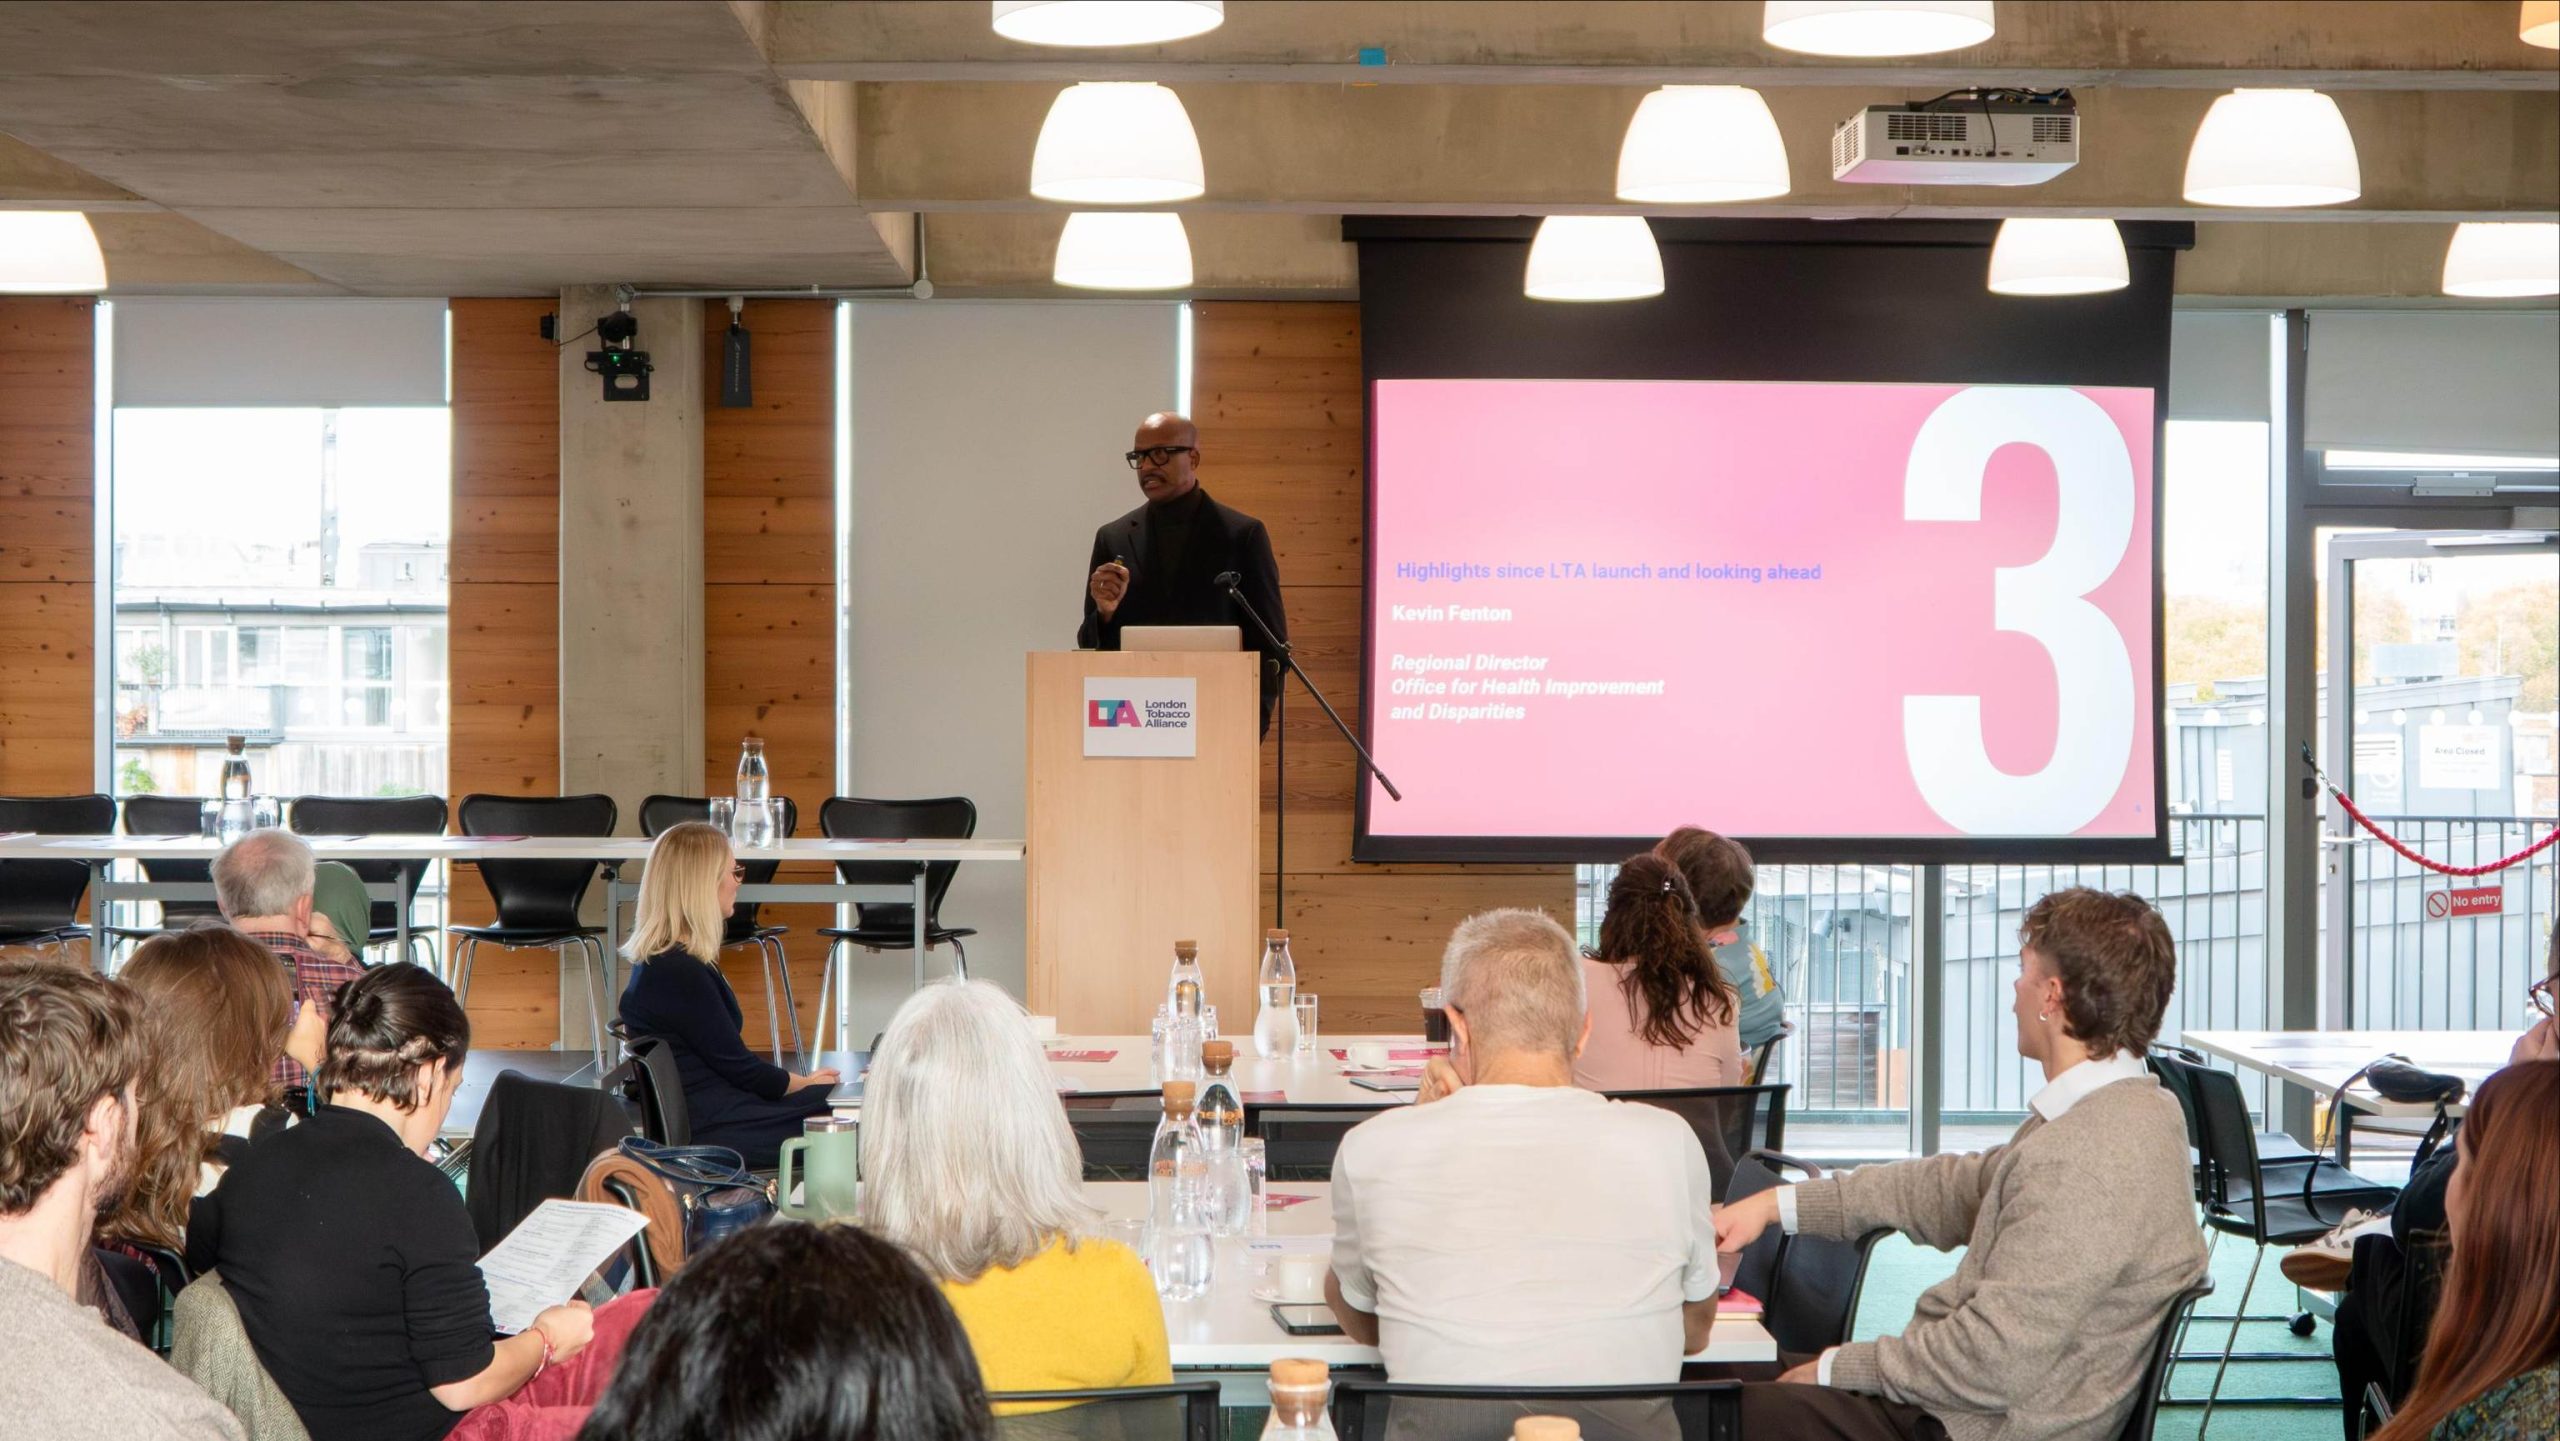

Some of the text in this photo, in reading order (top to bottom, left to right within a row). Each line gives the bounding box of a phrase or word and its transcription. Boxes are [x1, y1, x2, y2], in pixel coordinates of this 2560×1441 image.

[1396, 562, 1823, 583] Highlights since LTA launch and looking ahead
[1392, 605, 1512, 622] Kevin Fenton
[1903, 386, 2136, 836] 3
[1391, 654, 1548, 674] Regional Director
[1391, 678, 1665, 699] Office for Health Improvement
[1145, 699, 1187, 708] London
[1088, 700, 1142, 727] LTA
[1145, 709, 1191, 719] Tobacco
[1391, 703, 1526, 724] and Disparities
[1145, 718, 1188, 728] Alliance
[2455, 746, 2486, 755] Closed
[2453, 895, 2500, 907] No entry
